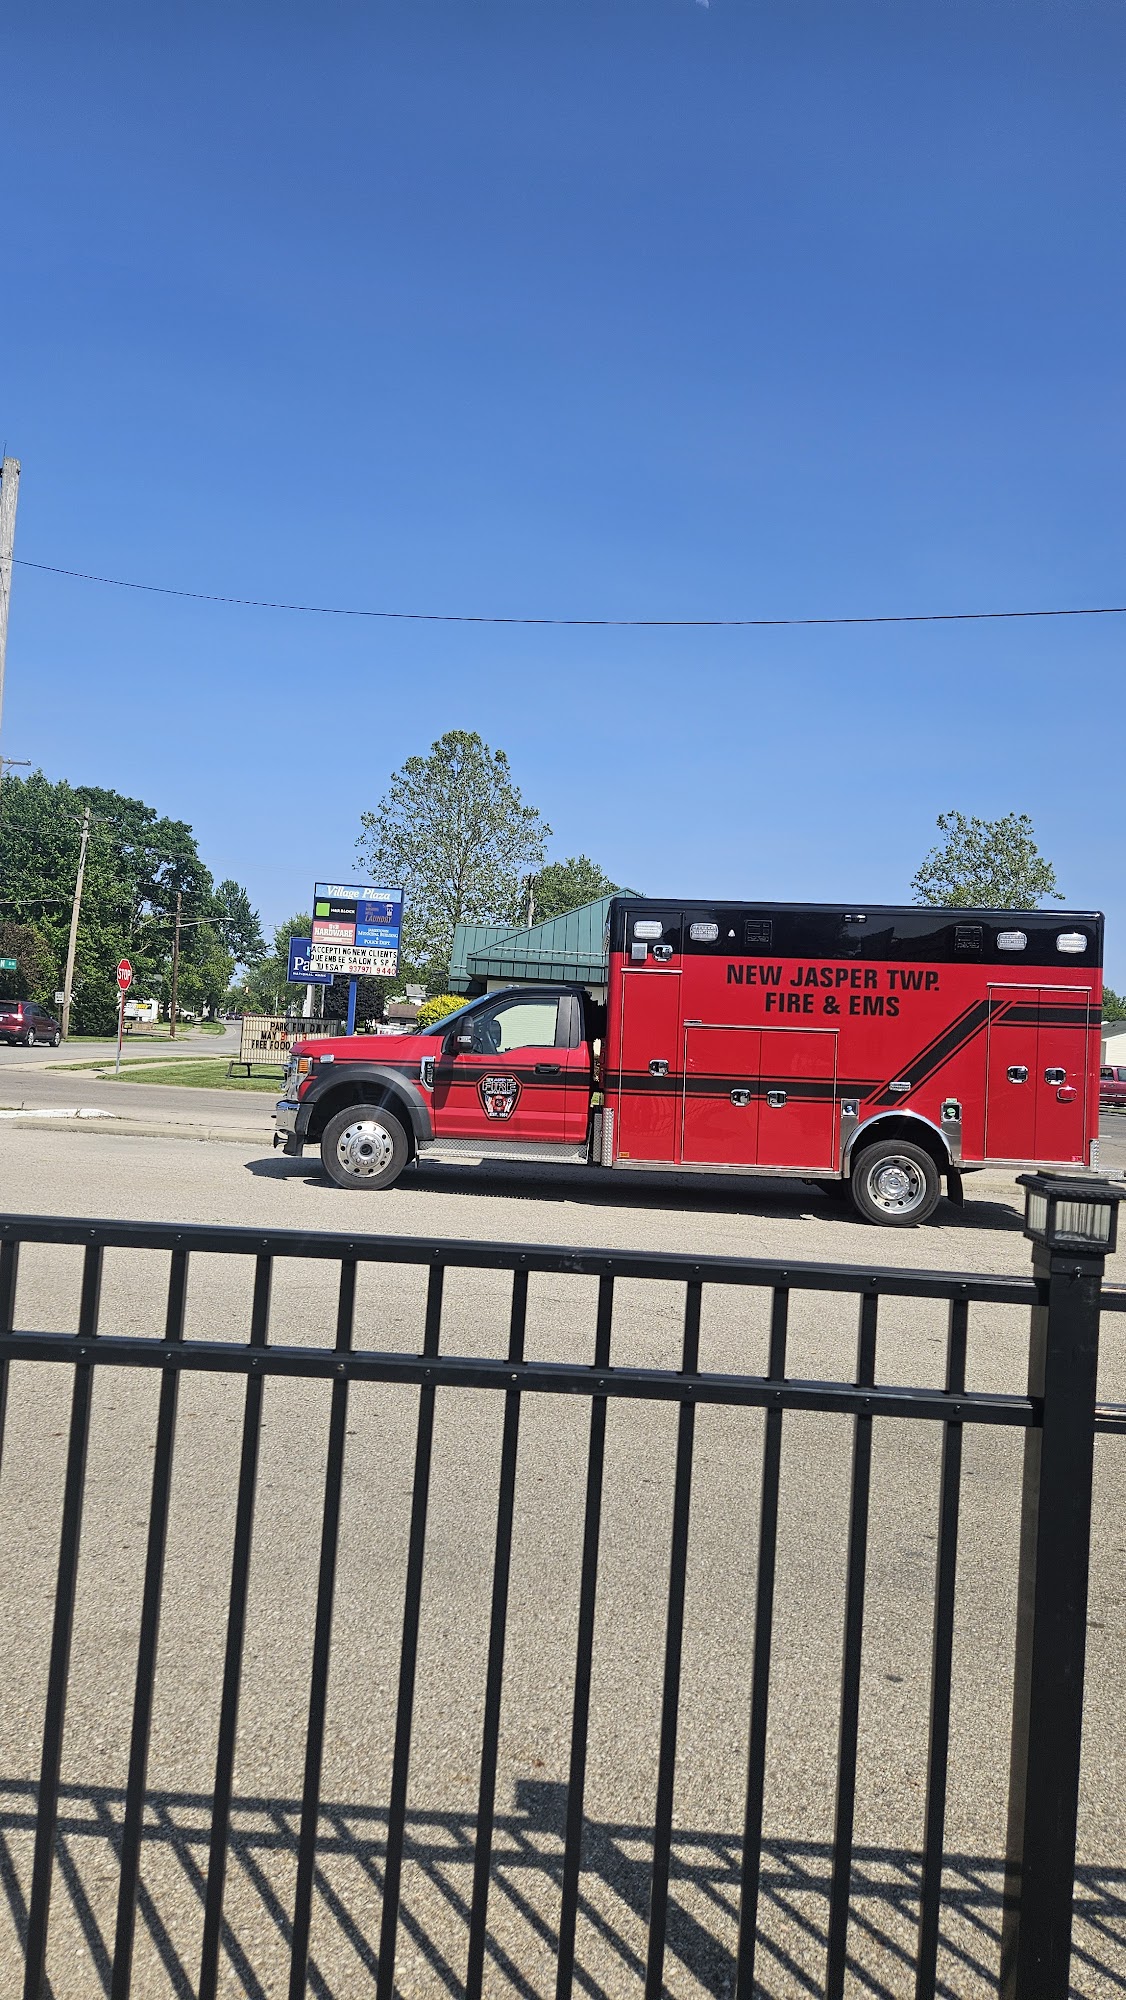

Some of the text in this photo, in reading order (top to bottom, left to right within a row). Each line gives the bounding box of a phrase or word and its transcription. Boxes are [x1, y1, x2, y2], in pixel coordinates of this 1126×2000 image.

[326, 885, 390, 900] Village Plaza
[365, 915, 392, 924] LAUNDRY
[314, 928, 353, 937] HARDWARE
[311, 945, 351, 955] ACCEPTING
[369, 950, 397, 958] CLIENTS
[348, 956, 371, 965] SALON
[118, 968, 130, 980] STOP
[726, 964, 940, 992] NEW JASPER TWP.
[764, 992, 900, 1017] FIRE & EMS
[270, 1022, 329, 1032] PARK FUN DAY
[261, 1031, 277, 1040] MAY
[252, 1040, 267, 1049] FREE
[270, 1041, 290, 1050] FOOD
[482, 1081, 517, 1092] FIRE
